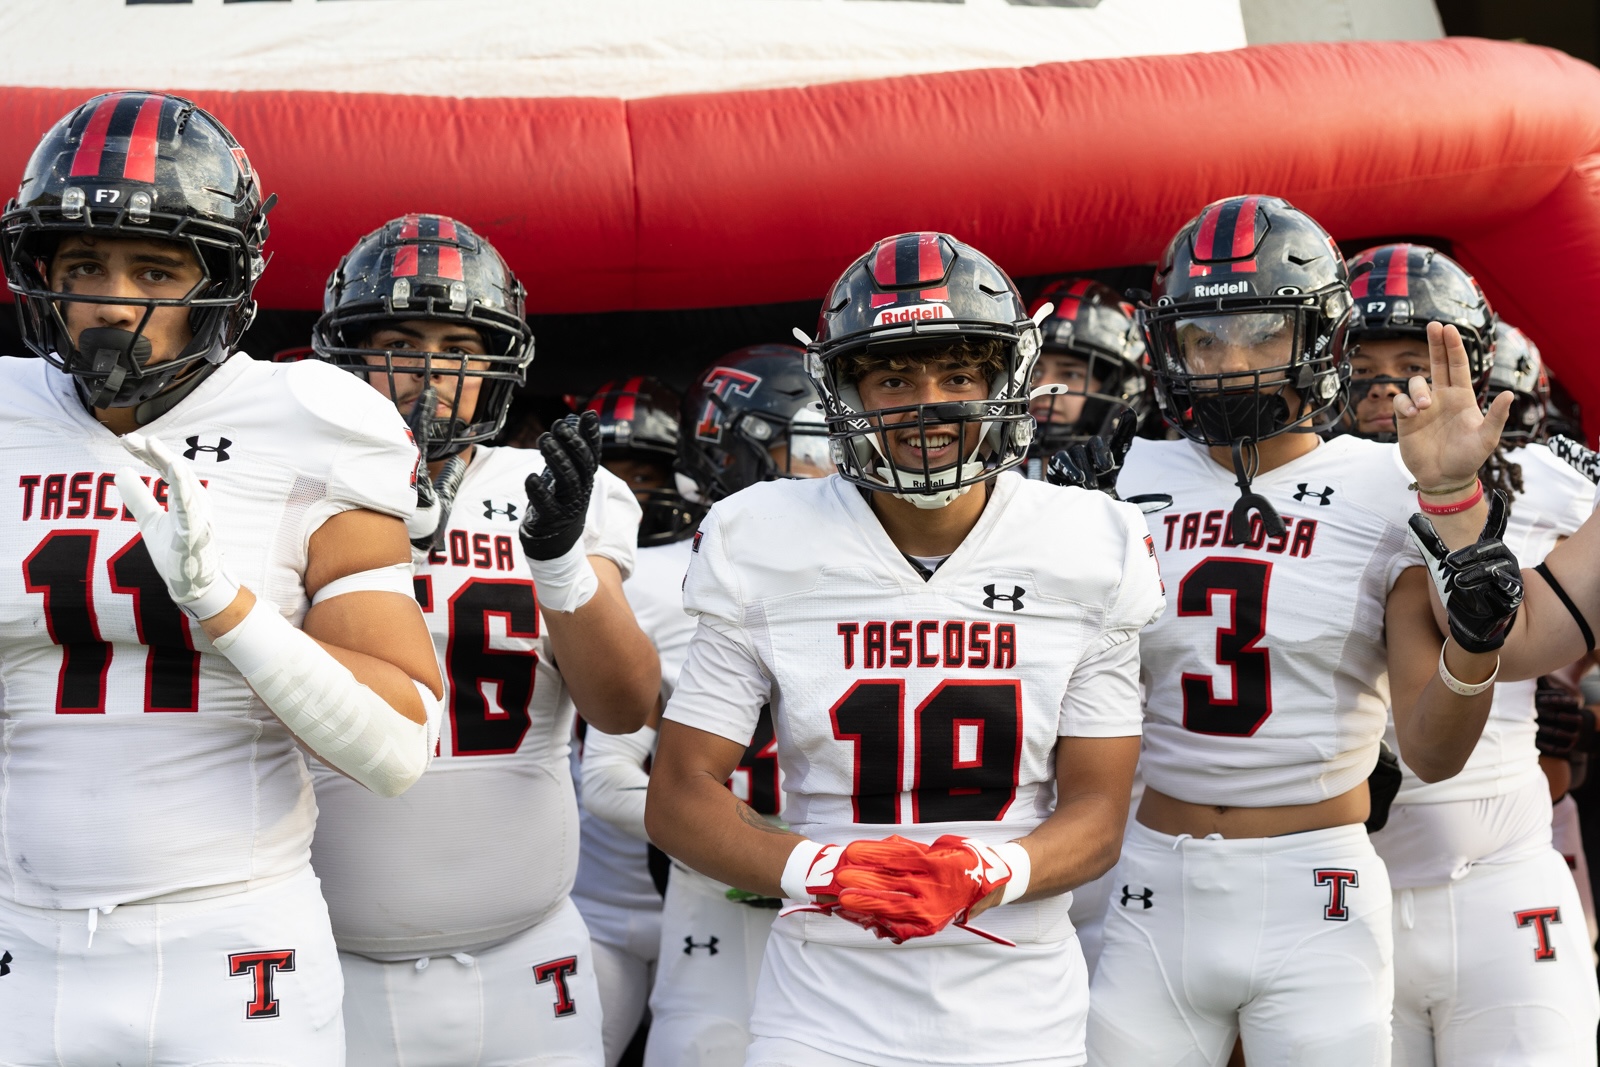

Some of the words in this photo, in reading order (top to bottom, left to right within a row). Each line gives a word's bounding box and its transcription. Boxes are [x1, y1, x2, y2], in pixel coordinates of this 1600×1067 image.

[95, 189, 120, 203] F7
[881, 305, 943, 325] Riddell
[1194, 281, 1248, 297] Riddell
[1367, 301, 1386, 313] F7
[22, 529, 201, 714] 11
[837, 620, 1016, 669] TASCOSA
[1177, 556, 1273, 737] 3
[1313, 868, 1358, 921] T
[1514, 907, 1562, 962] T
[228, 949, 295, 1019] T
[532, 955, 577, 1018] T
